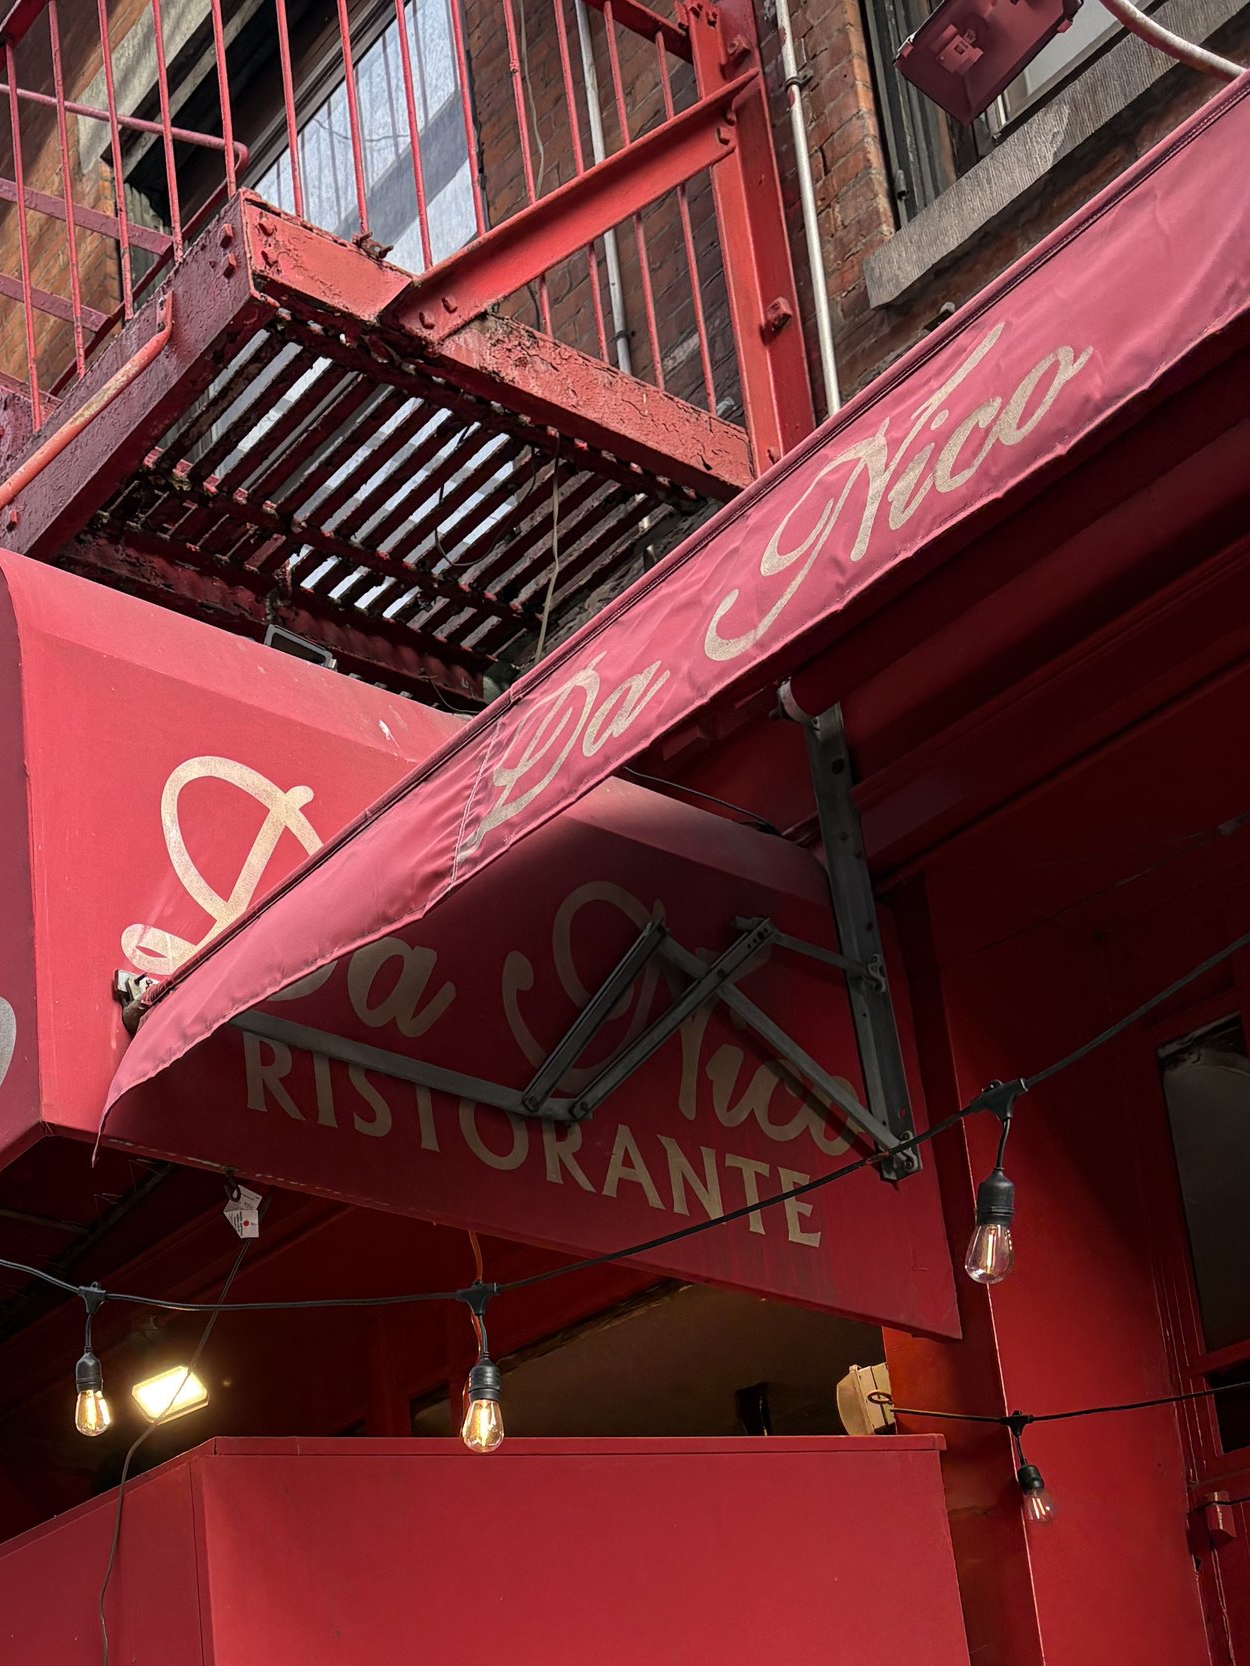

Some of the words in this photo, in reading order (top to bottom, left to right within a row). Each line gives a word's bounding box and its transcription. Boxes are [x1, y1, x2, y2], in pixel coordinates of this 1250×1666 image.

[458, 652, 670, 866] Da
[705, 324, 1092, 661] Nico
[243, 1030, 822, 1249] RISTORANTE
